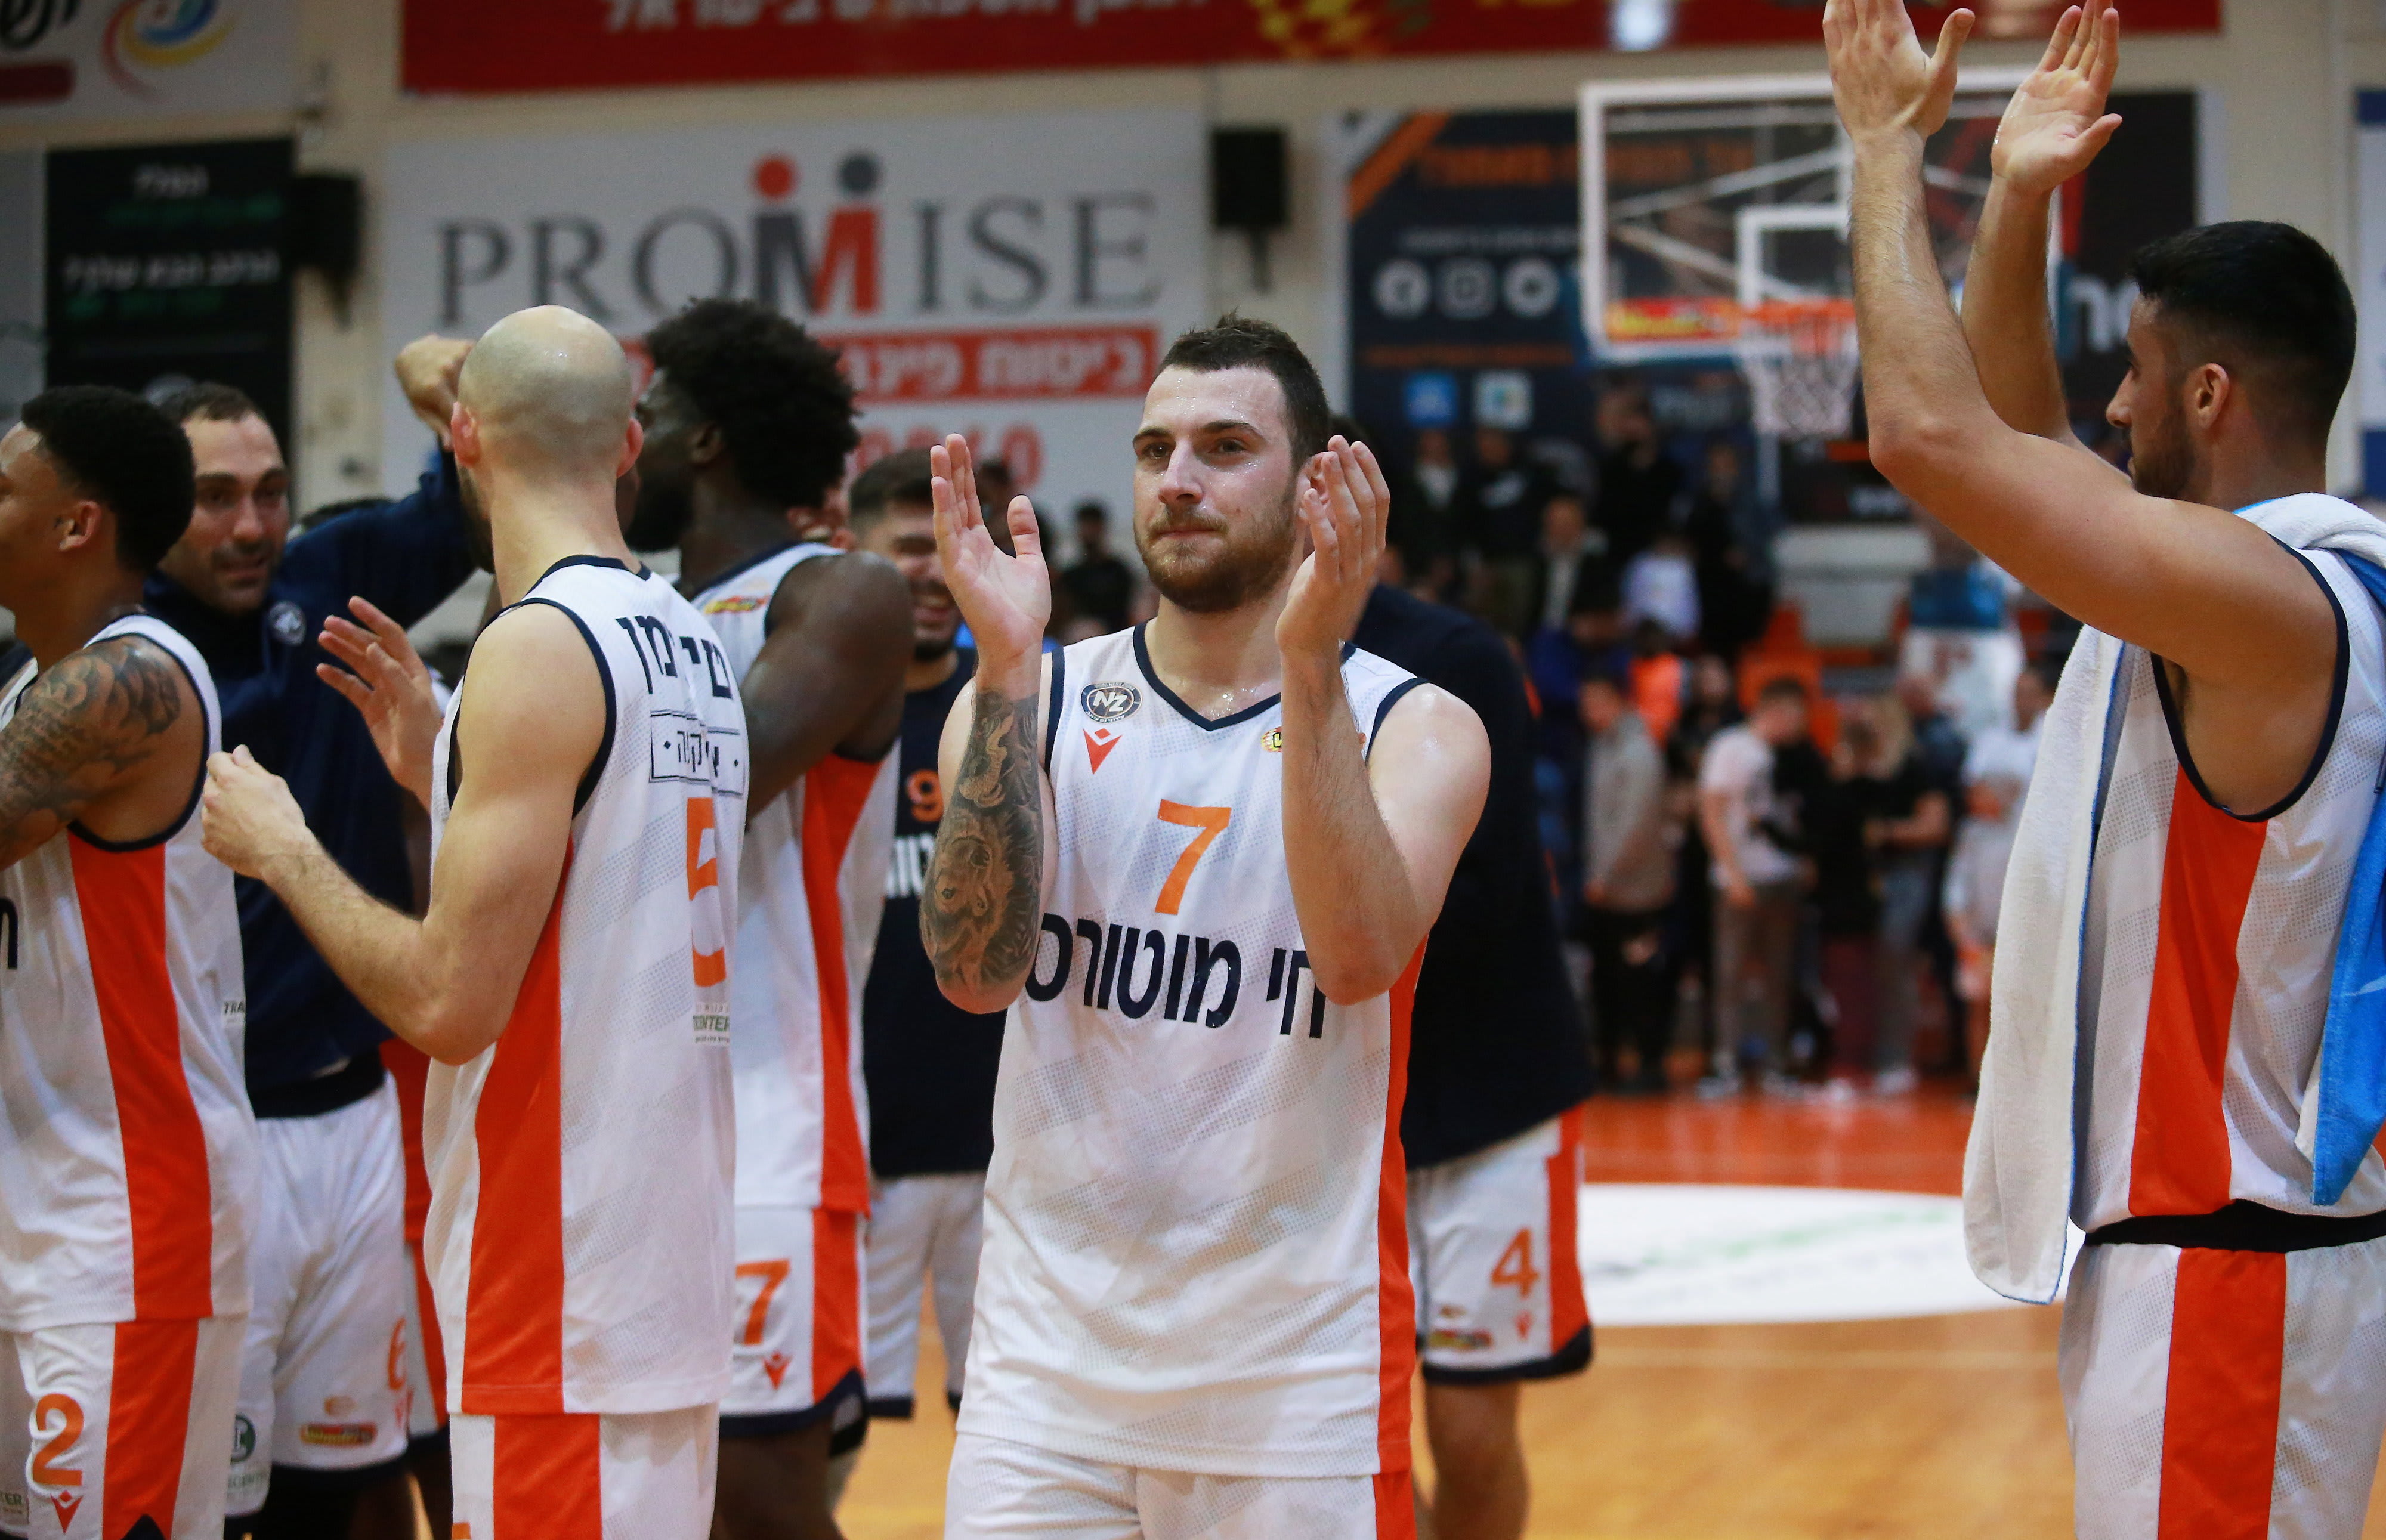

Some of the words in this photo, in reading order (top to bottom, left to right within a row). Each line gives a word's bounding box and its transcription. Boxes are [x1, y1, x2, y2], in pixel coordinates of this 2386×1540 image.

[437, 153, 1161, 327] PROMISE
[1093, 691, 1127, 712] NZ
[907, 769, 944, 822] 9
[1154, 799, 1232, 915] 7
[1025, 913, 1241, 1028] מוטורס
[735, 1258, 791, 1346] 7
[1491, 1227, 1540, 1298] 4
[33, 1393, 85, 1486] 2
